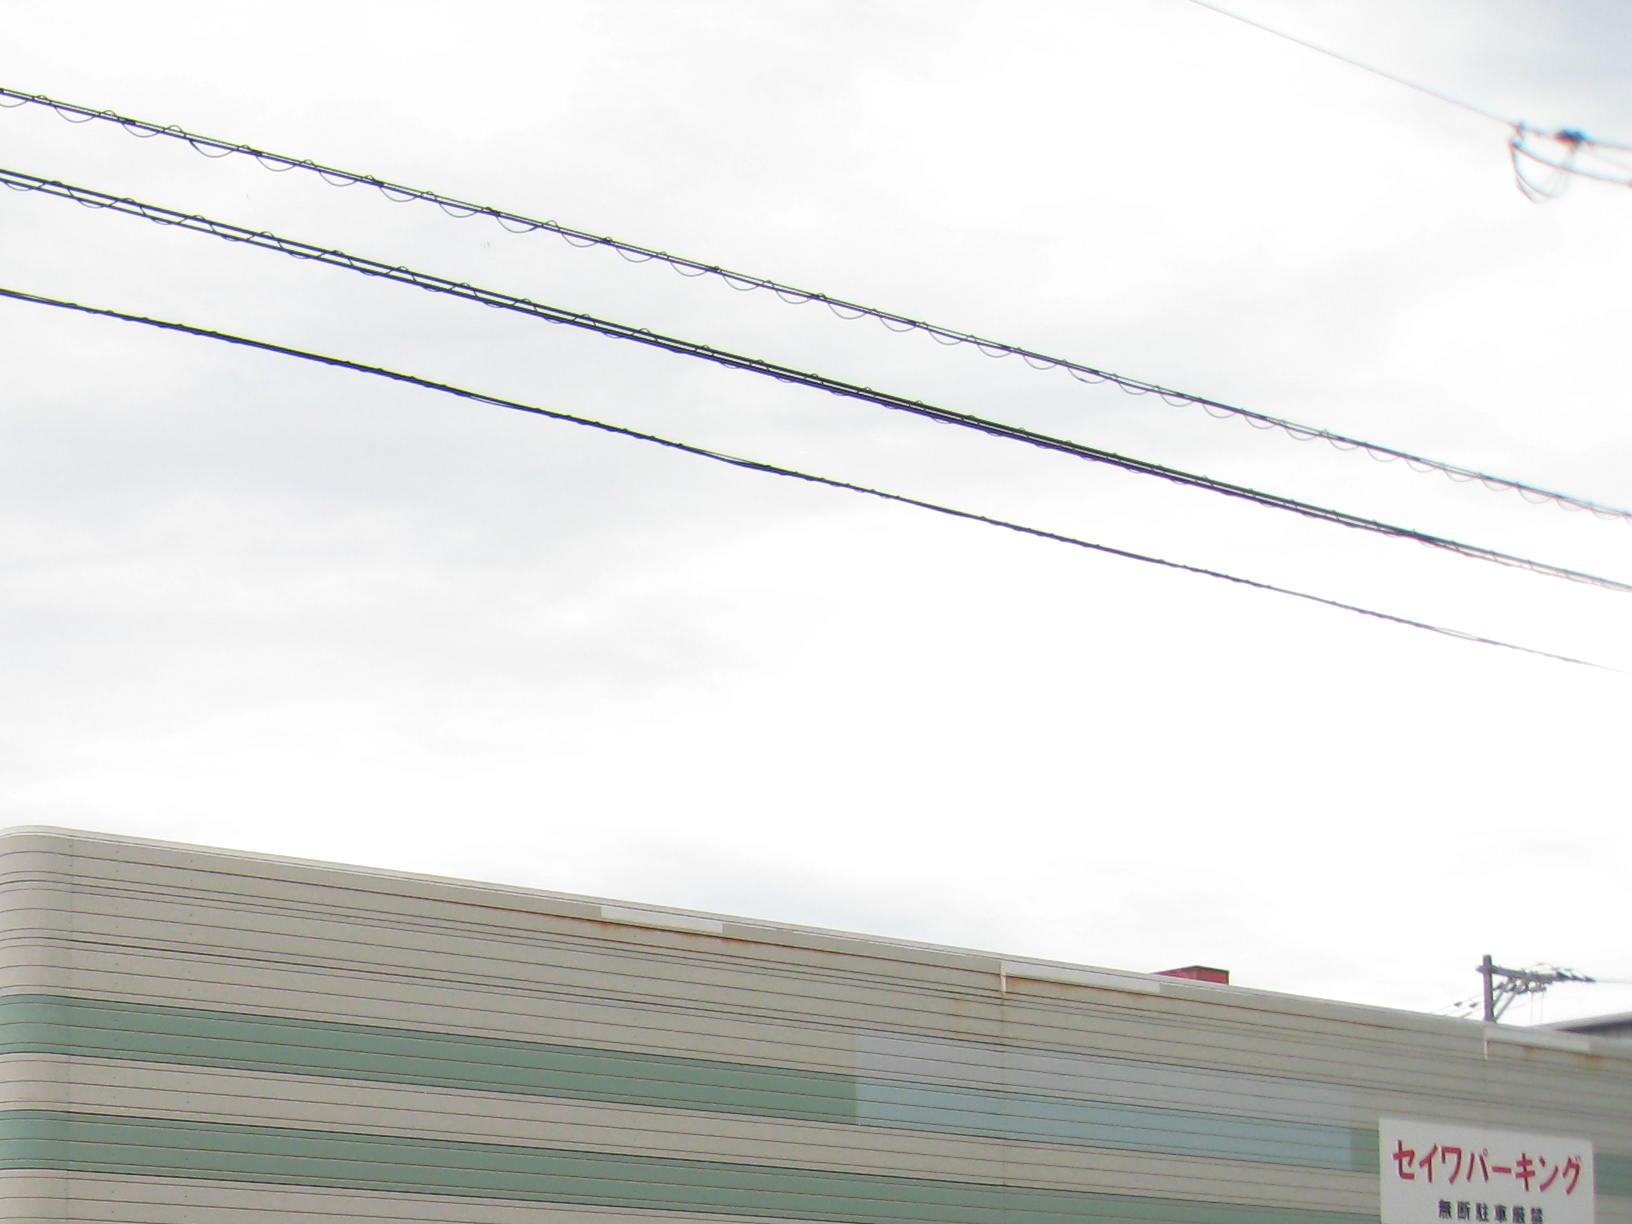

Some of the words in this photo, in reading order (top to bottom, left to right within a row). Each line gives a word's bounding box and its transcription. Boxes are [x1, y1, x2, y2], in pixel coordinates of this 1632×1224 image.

[1393, 1139, 1582, 1196] セイワパーキング
